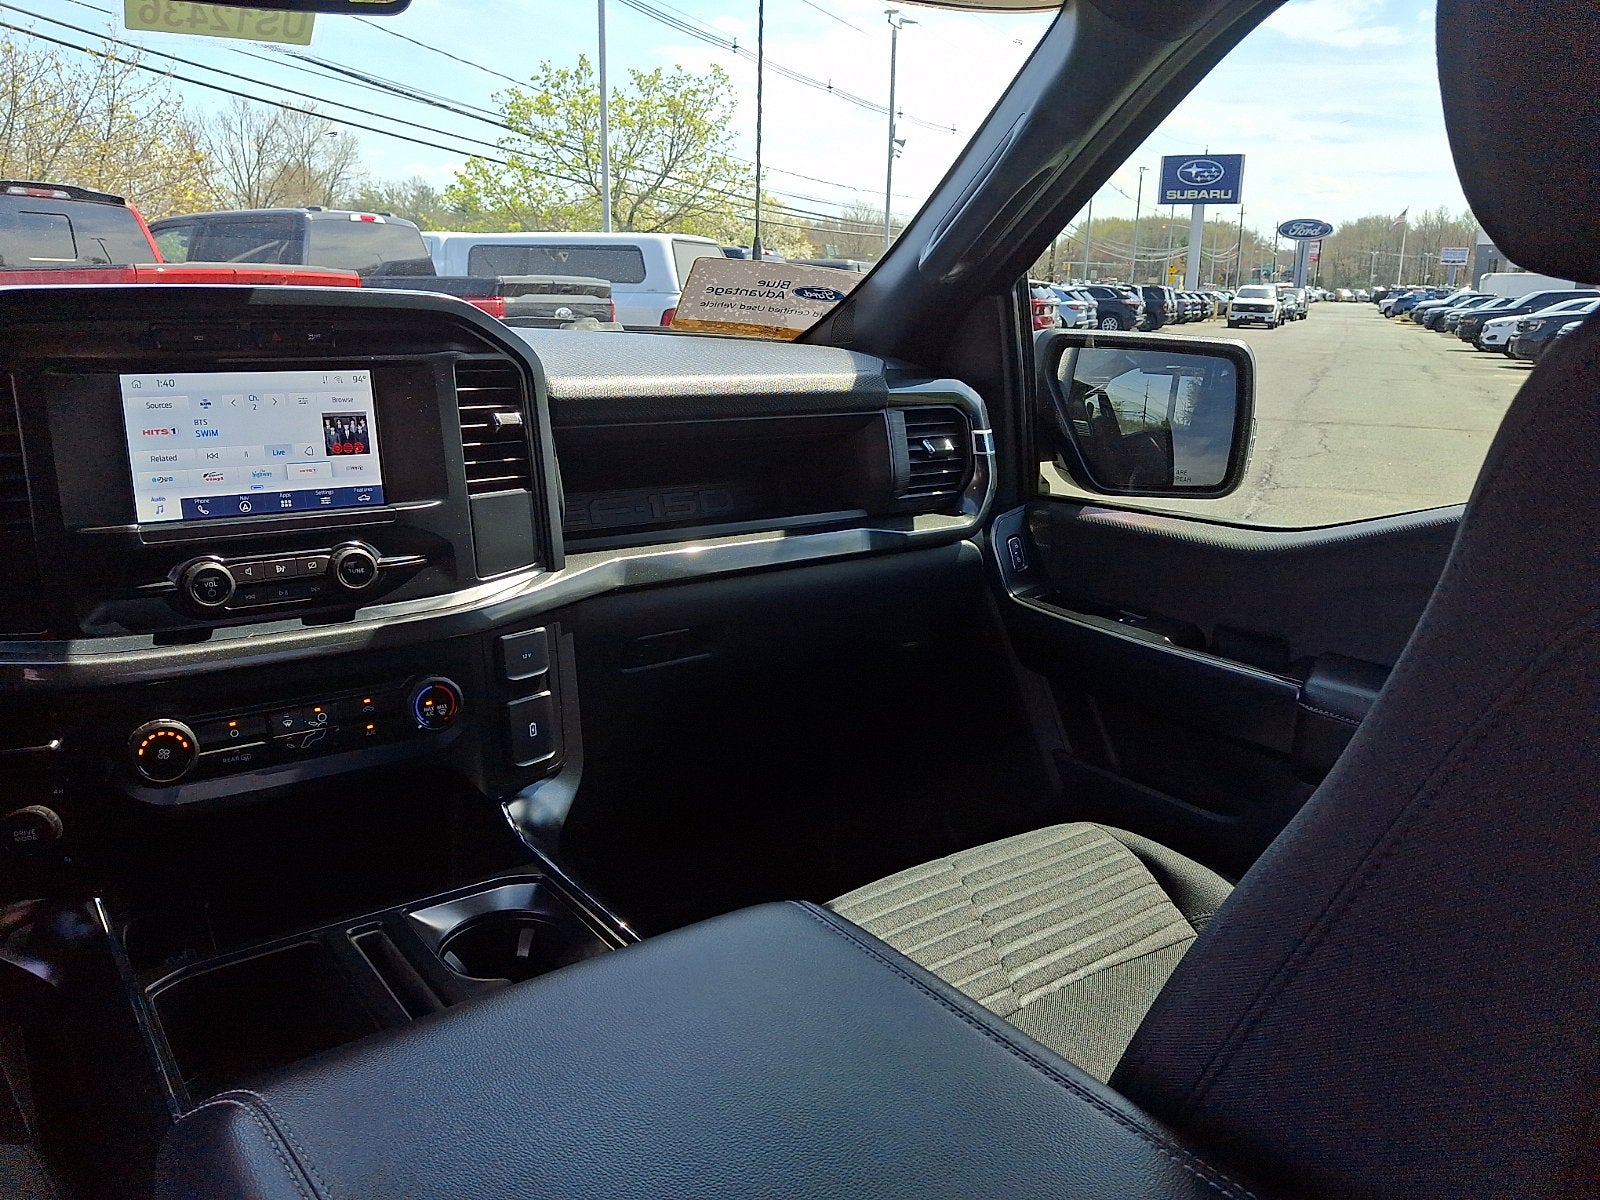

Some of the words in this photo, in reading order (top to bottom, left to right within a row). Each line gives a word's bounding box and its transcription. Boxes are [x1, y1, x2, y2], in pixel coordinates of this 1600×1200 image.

[1166, 189, 1233, 200] SUBARU
[1287, 222, 1321, 236] Ford
[156, 379, 175, 388] 1:40
[145, 401, 173, 410] Sources
[193, 418, 208, 426] BTS
[195, 429, 219, 437] SWIM
[150, 454, 178, 463] Related
